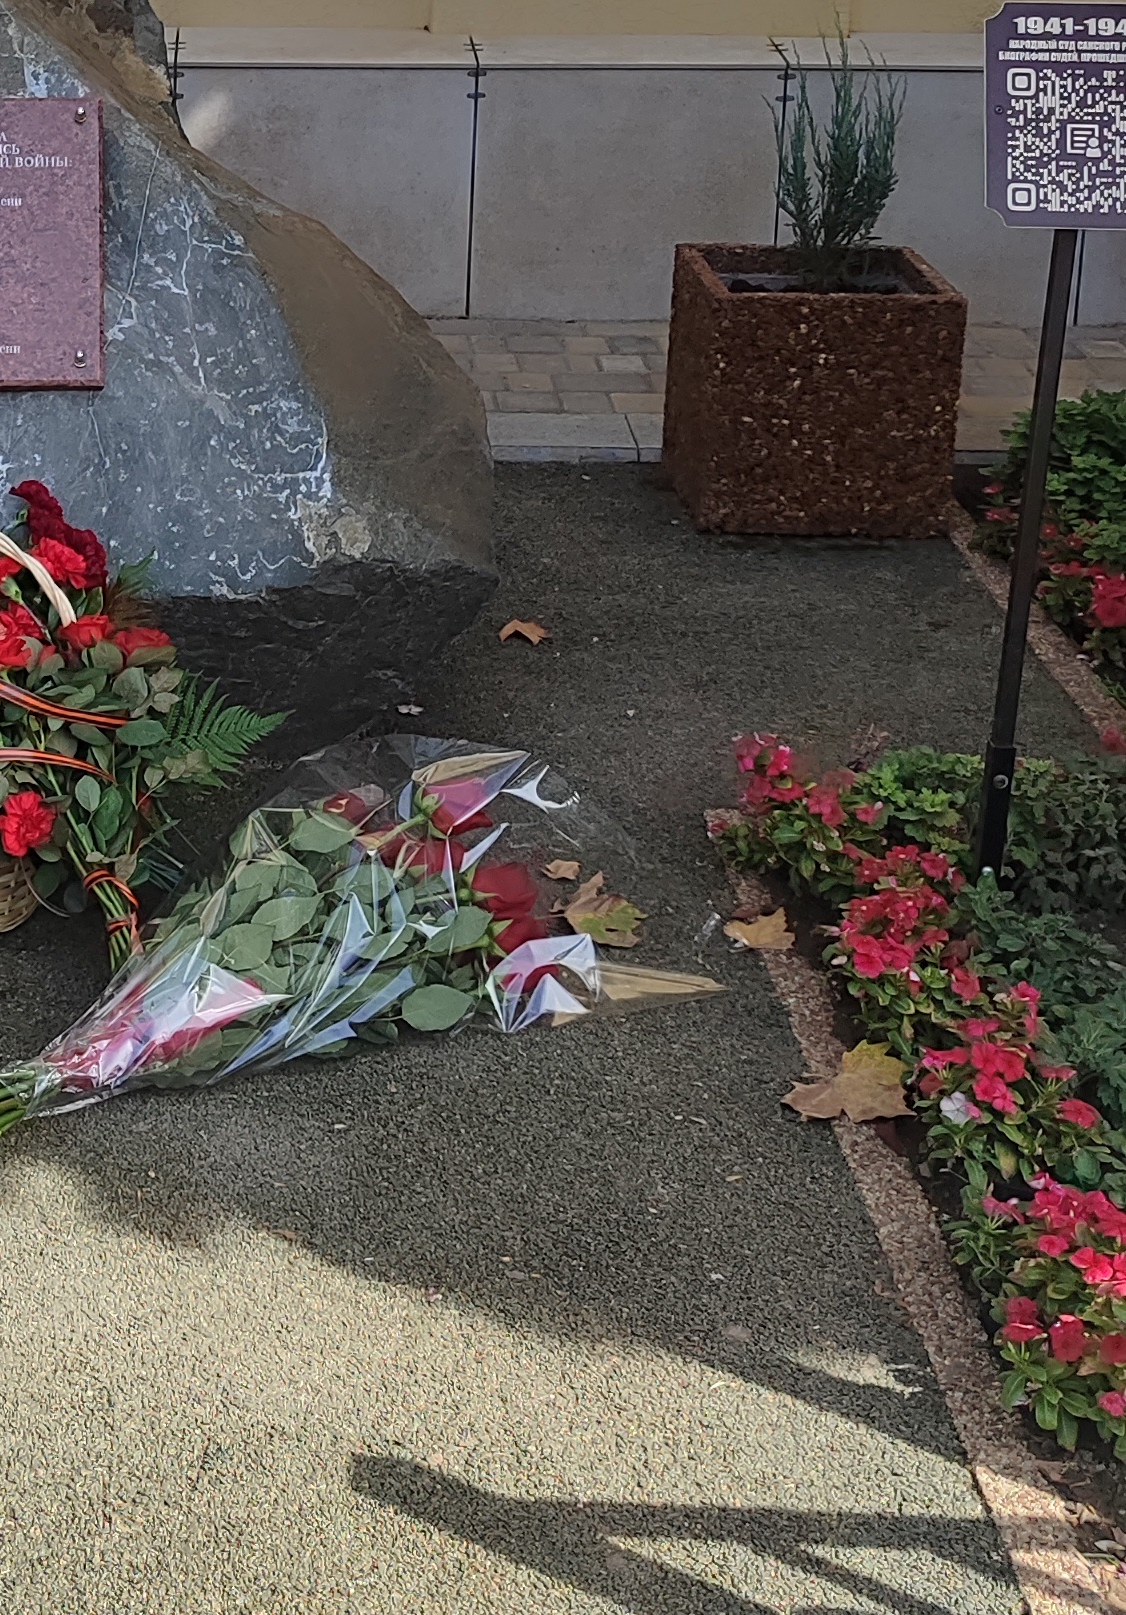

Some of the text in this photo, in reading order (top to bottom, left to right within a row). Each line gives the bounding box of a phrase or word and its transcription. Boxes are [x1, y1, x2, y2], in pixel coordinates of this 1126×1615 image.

[1009, 39, 1057, 50] НАРОДНЫЙ
[1058, 40, 1075, 51] СУД
[1077, 41, 1120, 51] САКСКОГО
[999, 51, 1049, 61] БИОГРАФИИ
[15, 154, 73, 168] ВОЙНЫ:
